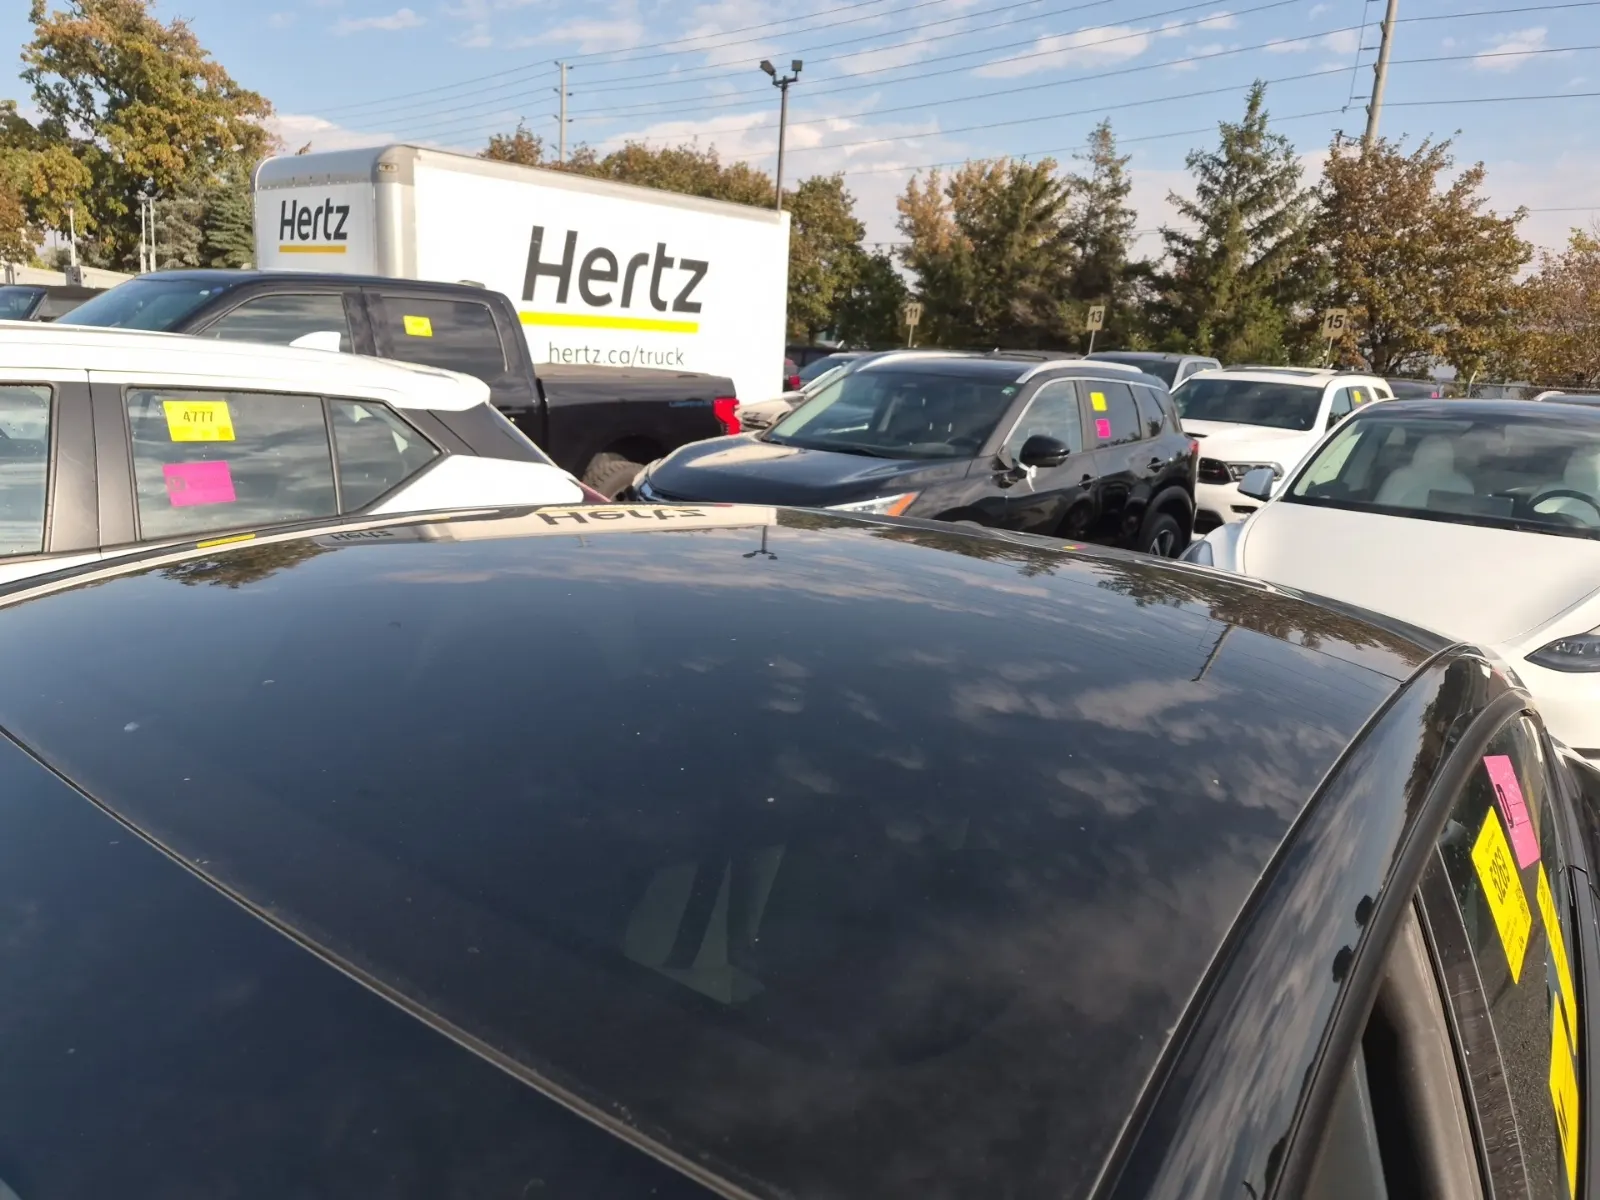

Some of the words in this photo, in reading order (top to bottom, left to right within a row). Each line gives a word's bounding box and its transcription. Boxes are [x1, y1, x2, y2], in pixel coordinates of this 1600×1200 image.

[279, 197, 350, 241] Hertz
[521, 225, 709, 314] Hertz
[1090, 310, 1102, 323] 13
[1326, 314, 1344, 329] 15
[549, 341, 684, 367] hertz.ca/truck
[183, 410, 213, 422] 4777
[1489, 845, 1510, 905] 5269
